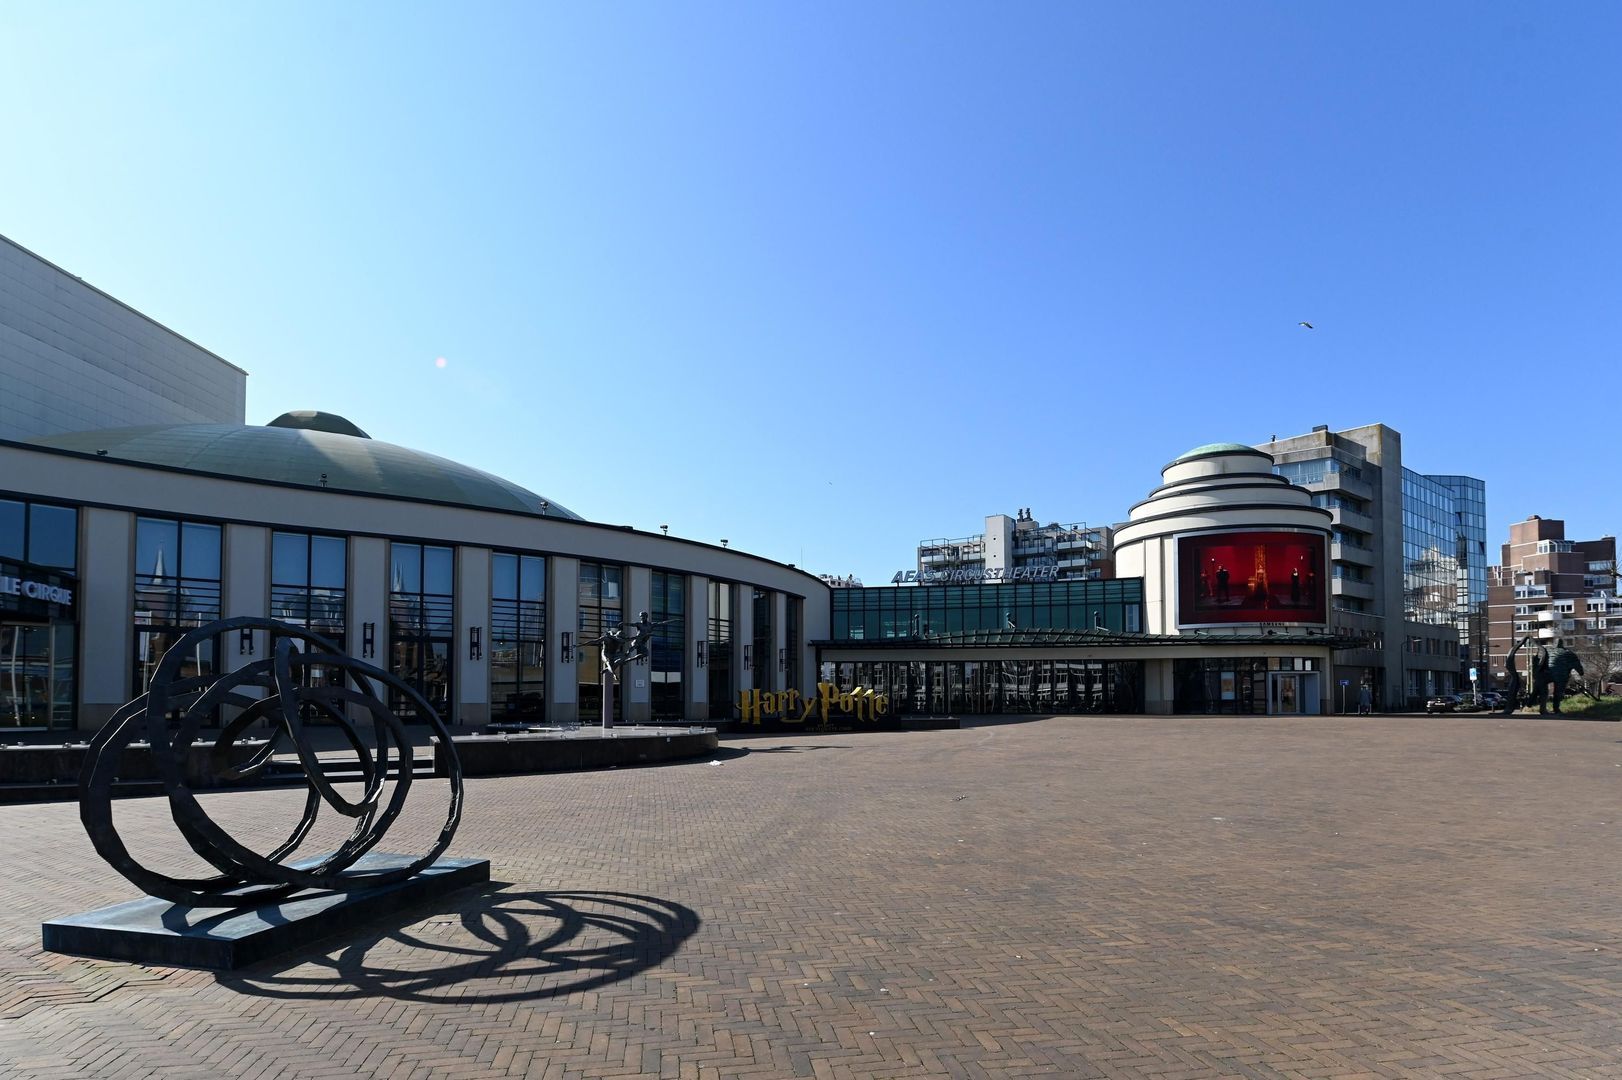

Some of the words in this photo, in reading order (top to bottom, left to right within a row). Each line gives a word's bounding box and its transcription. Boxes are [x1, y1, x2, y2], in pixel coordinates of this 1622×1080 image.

[0, 576, 21, 595] LE
[21, 581, 72, 605] CIRQUE
[891, 570, 936, 583] AFAS
[735, 688, 816, 724] Harry
